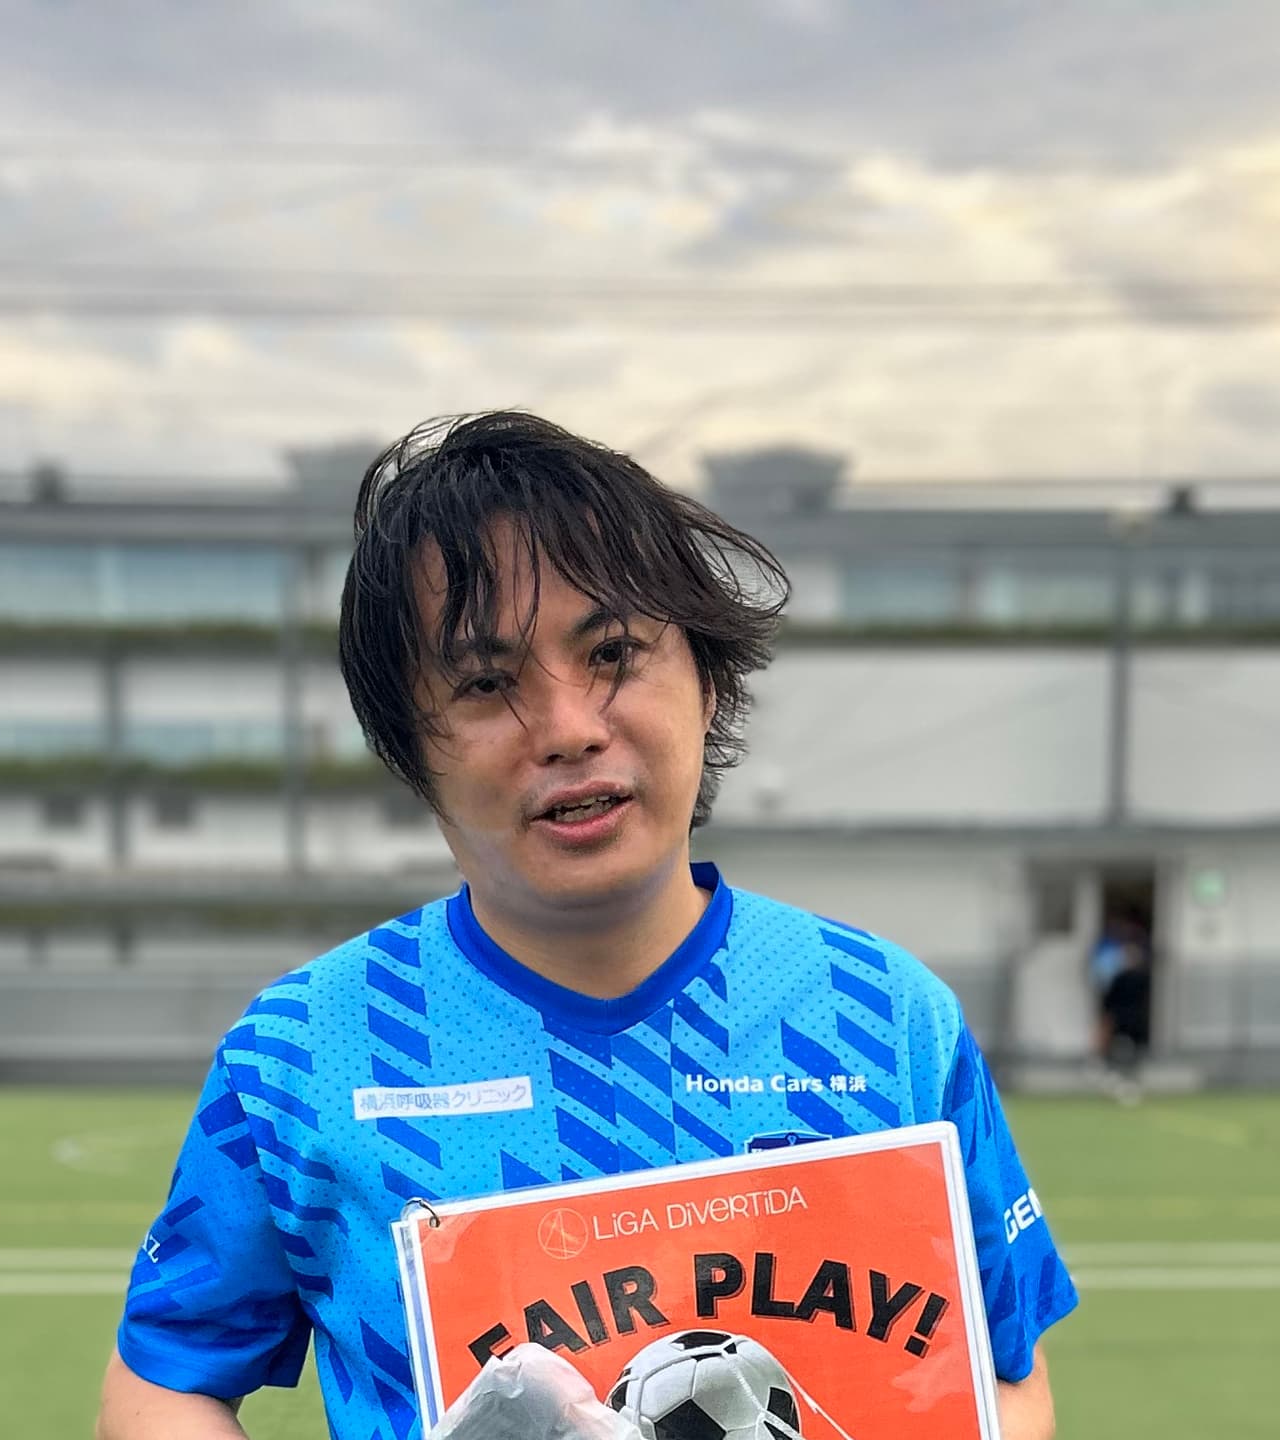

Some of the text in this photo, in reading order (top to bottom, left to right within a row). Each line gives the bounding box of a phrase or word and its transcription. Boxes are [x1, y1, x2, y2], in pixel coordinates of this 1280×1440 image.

[685, 1074, 867, 1092] Honda Cars 横浜
[693, 1251, 949, 1359] PLAY!
